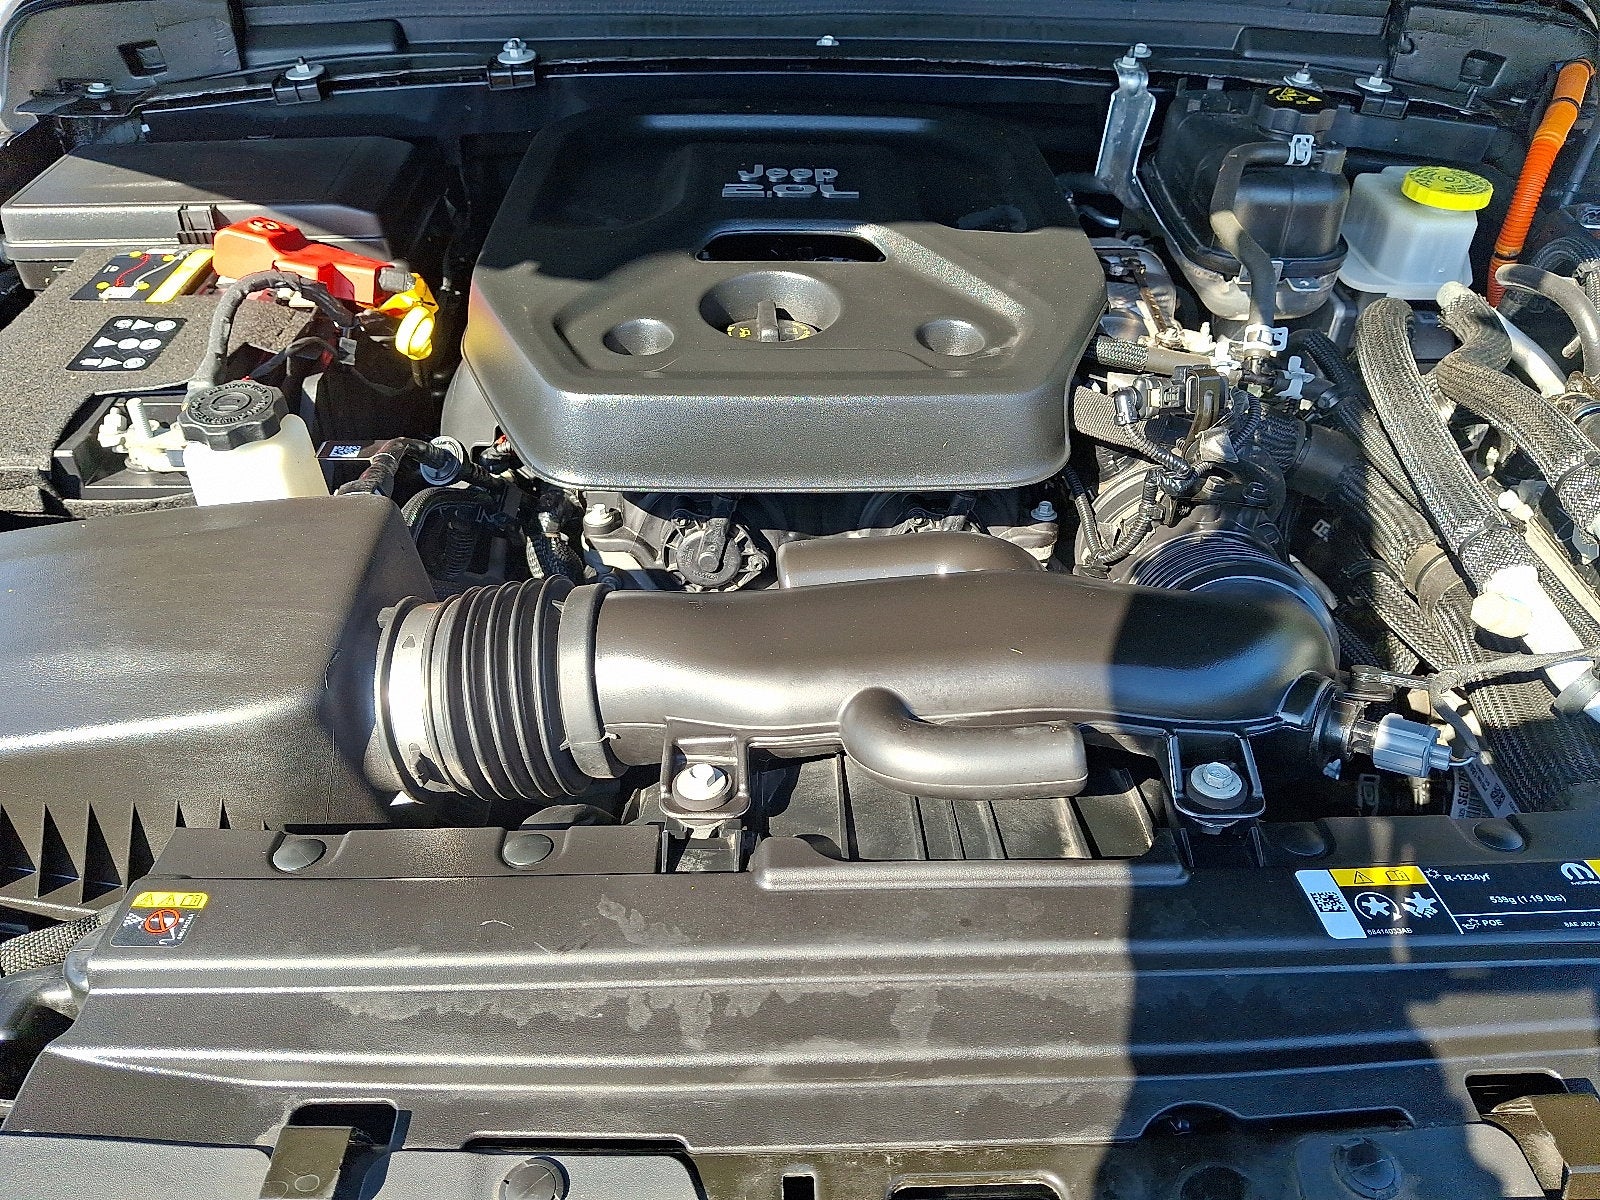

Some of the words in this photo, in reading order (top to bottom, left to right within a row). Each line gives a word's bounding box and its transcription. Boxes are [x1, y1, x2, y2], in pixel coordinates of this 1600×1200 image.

[738, 164, 839, 184] Jeep
[722, 183, 860, 199] 2.0L
[1443, 872, 1491, 882] R-1234yf
[1489, 895, 1518, 905] 539g
[1518, 894, 1544, 905] (1.19
[1544, 893, 1567, 903] lbs)
[1481, 919, 1504, 927] POE
